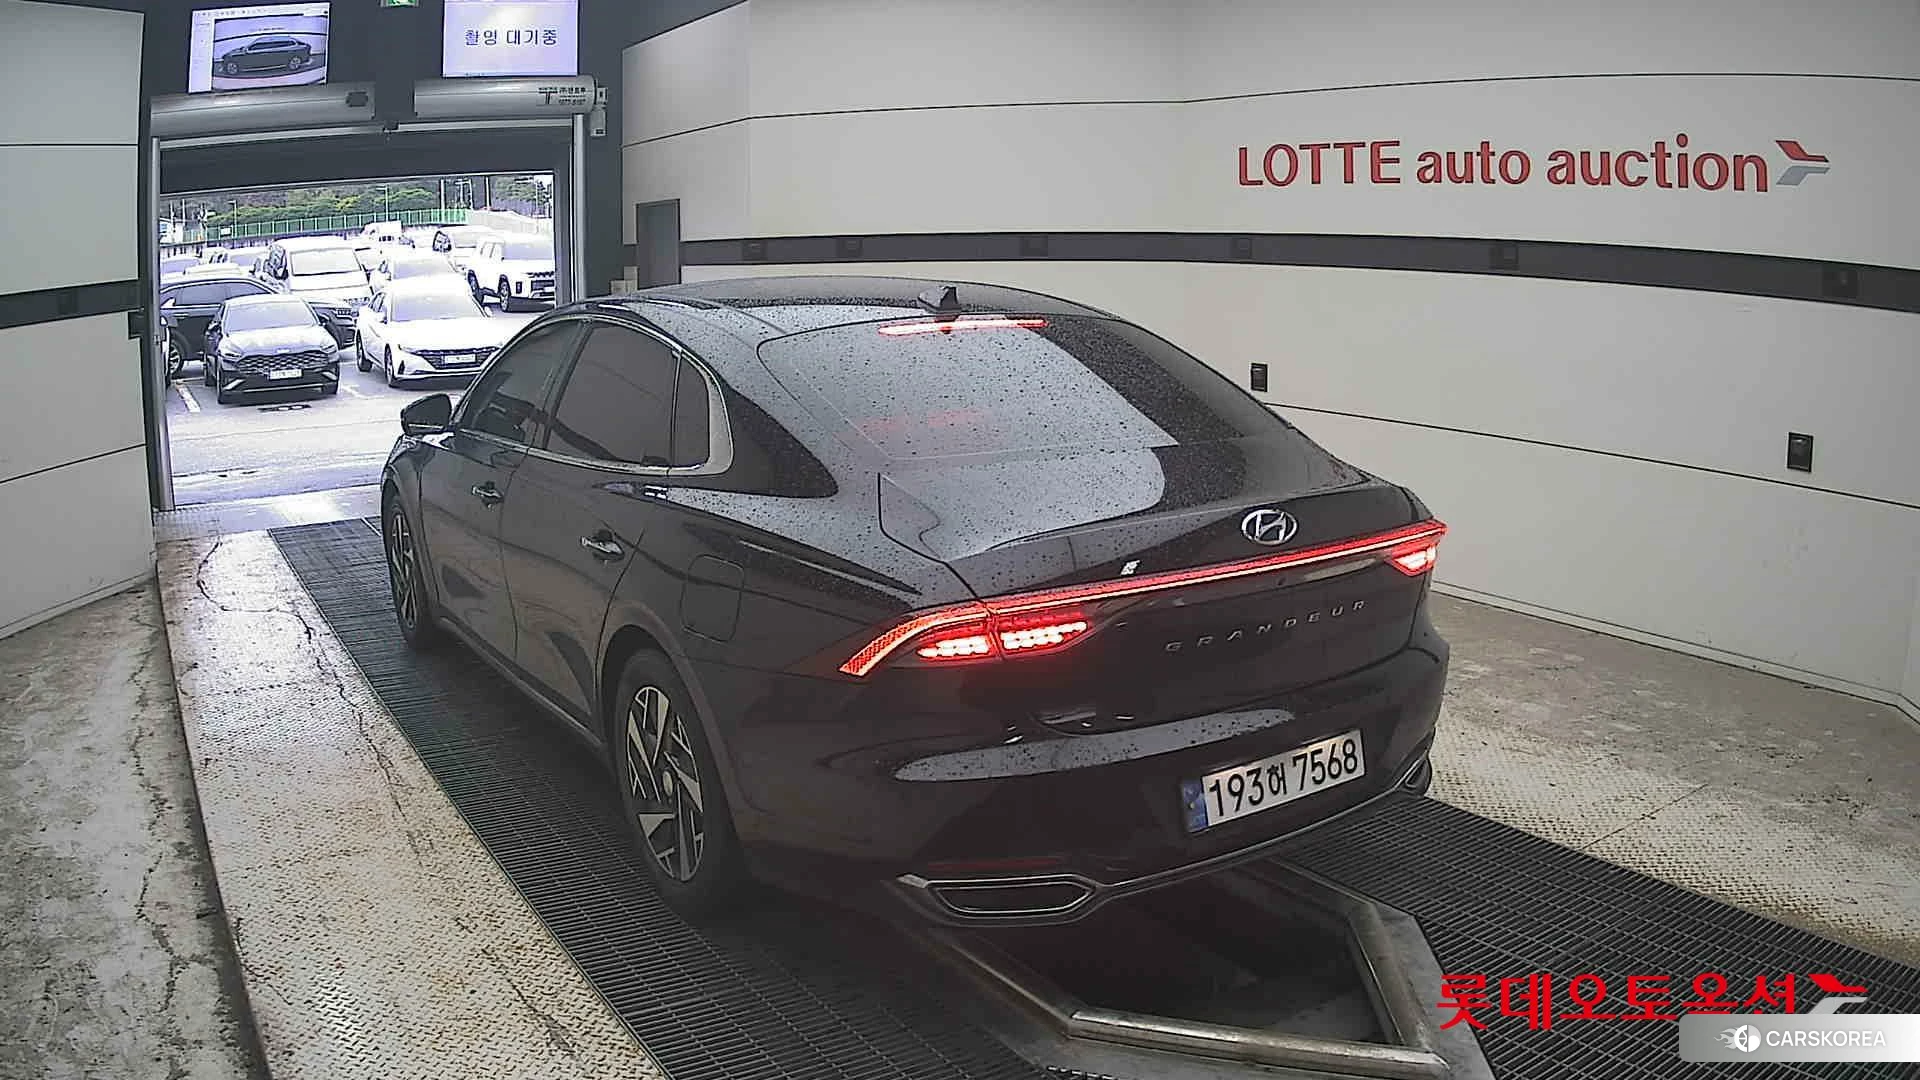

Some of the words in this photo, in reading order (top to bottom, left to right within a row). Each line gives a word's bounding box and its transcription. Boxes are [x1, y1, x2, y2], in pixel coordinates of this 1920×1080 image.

[465, 29, 498, 46] 촬영
[506, 29, 558, 46] 대기중
[1238, 140, 1401, 187] LOTTE
[1416, 140, 1531, 185] auto
[1546, 133, 1769, 192] auction
[1165, 600, 1366, 651] GRANDEUR
[1209, 762, 1288, 817] 193허
[1293, 738, 1358, 791] 7568
